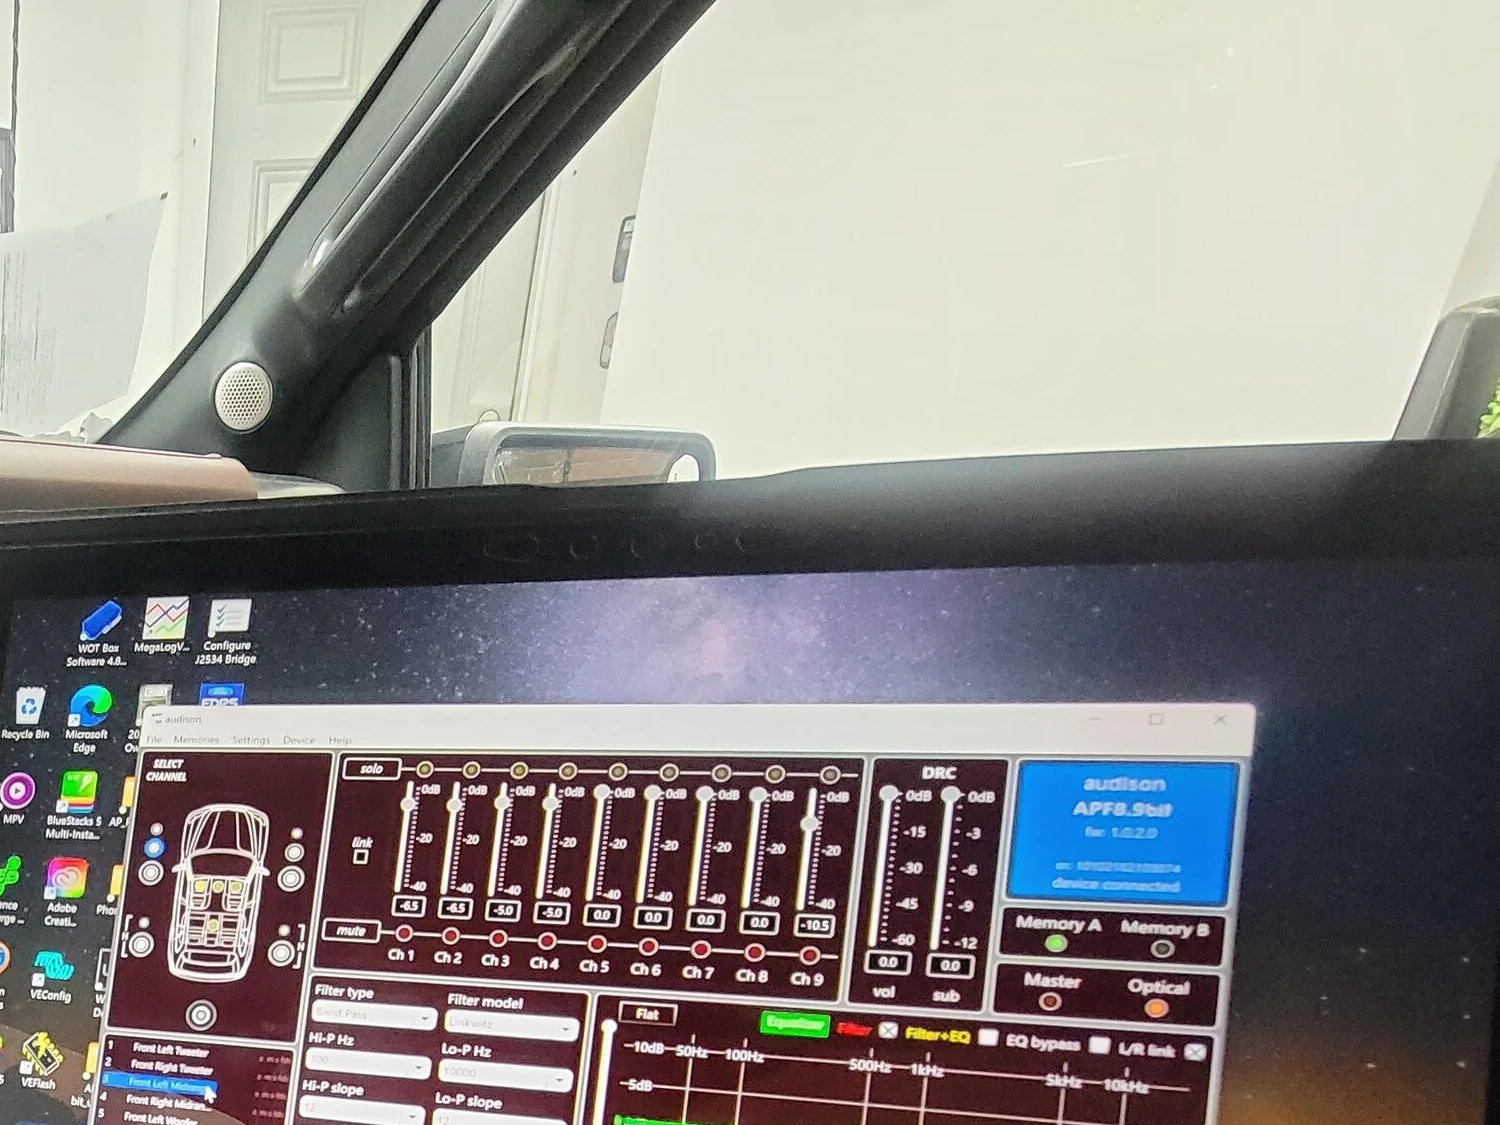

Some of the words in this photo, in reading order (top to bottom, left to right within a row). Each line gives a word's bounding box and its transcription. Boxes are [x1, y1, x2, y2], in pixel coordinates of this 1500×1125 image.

[204, 641, 251, 651] Configure
[67, 657, 105, 667] Software
[195, 654, 223, 665] J2534
[225, 655, 257, 665] Bridge
[166, 716, 202, 724] audison
[2, 730, 33, 741] Recycle
[36, 730, 50, 739] Bin
[66, 730, 108, 741] Microsoft
[174, 736, 219, 744] Memories
[233, 736, 270, 745] Settings
[283, 736, 315, 744] Device
[329, 736, 352, 745] Help
[73, 743, 96, 755] Edge
[153, 759, 184, 769] SELECT
[360, 764, 383, 774] solo
[146, 772, 187, 782] CHANNEL
[922, 766, 957, 779] DRC
[1083, 777, 1166, 792] audison
[3, 815, 24, 824] MPV
[352, 837, 373, 848] link
[47, 903, 77, 913] Adobe
[1016, 915, 1085, 934] Memory
[1088, 919, 1102, 932] A
[1121, 920, 1194, 939] Memory
[1197, 924, 1210, 936] B
[336, 926, 366, 936] mute
[1024, 972, 1082, 988] Master
[315, 984, 346, 998] Filter
[348, 987, 374, 1000] type
[872, 985, 896, 998] vol
[1127, 979, 1191, 995] Optical
[31, 989, 72, 1003] VEConfig
[932, 989, 961, 1002] sub
[448, 994, 479, 1008] Filter
[482, 997, 524, 1010] model
[1006, 1033, 1028, 1047] EQ
[1031, 1035, 1081, 1052] bypass
[22, 1077, 55, 1090] VEFlash
